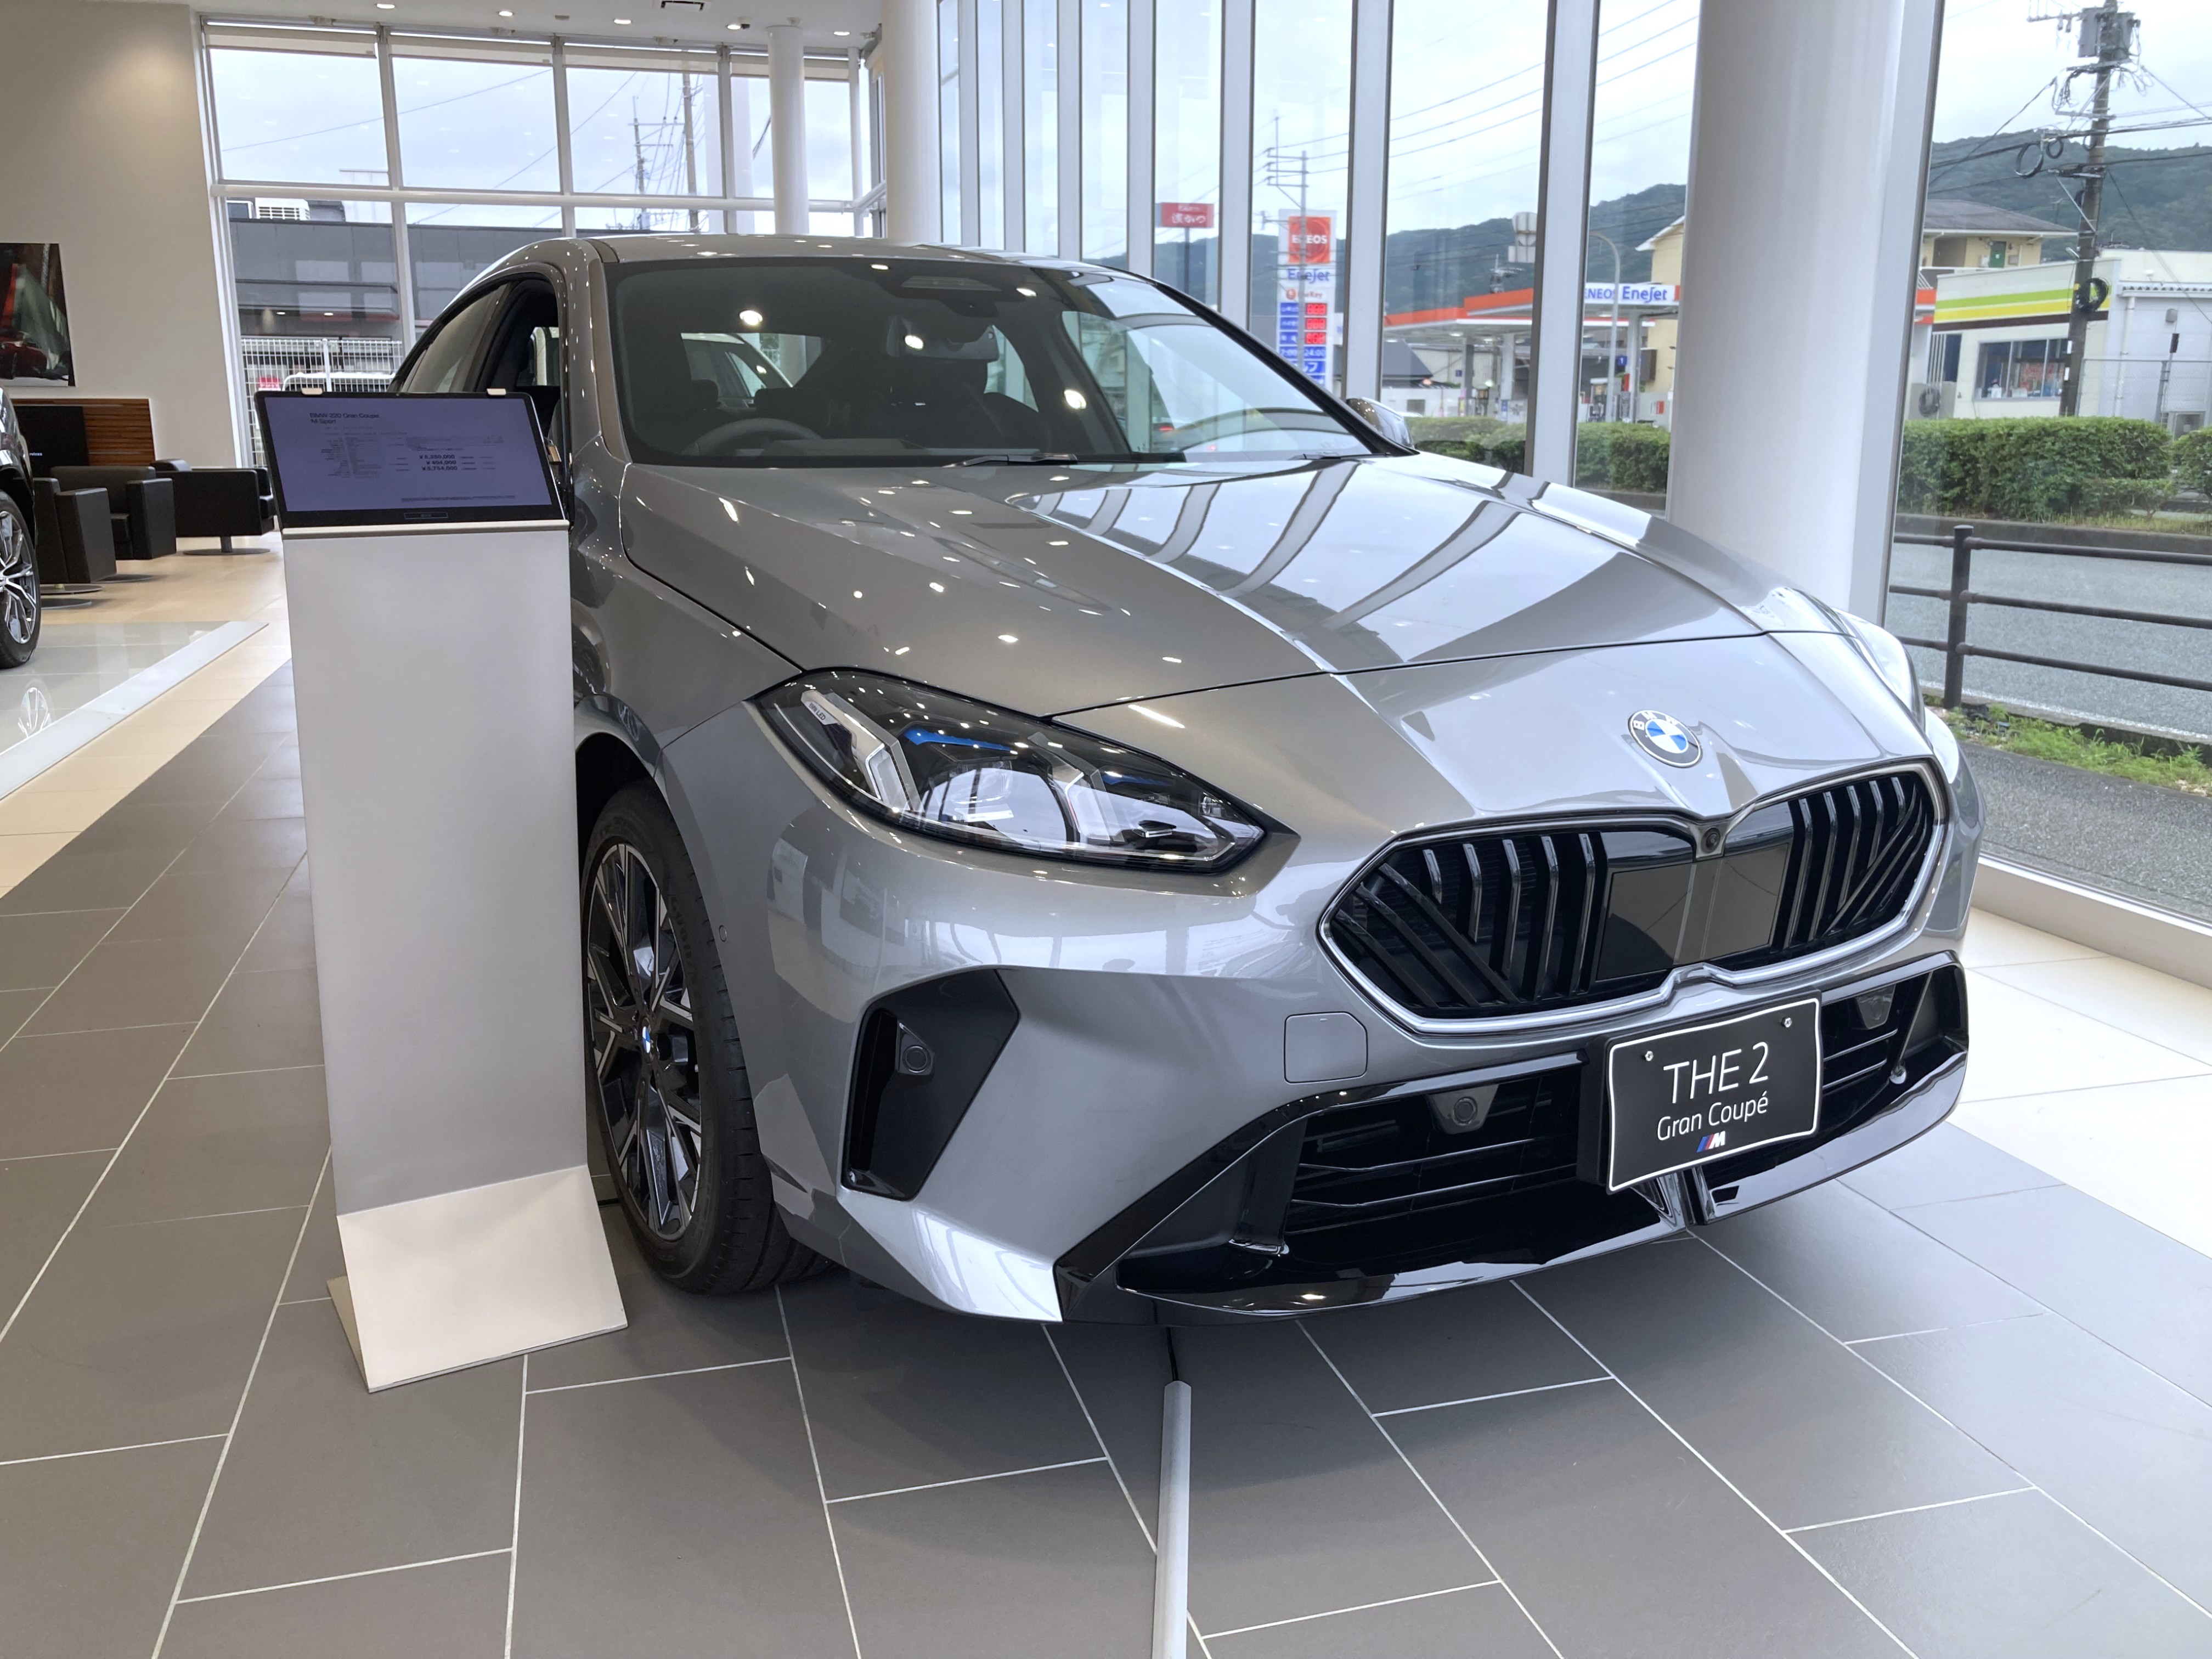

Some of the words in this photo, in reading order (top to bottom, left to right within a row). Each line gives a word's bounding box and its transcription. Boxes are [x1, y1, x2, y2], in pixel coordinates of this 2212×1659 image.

[1584, 288, 1615, 299] NEO
[816, 710, 826, 720] LED
[1633, 711, 1679, 731] BMW
[1663, 1048, 1742, 1104] THE
[1749, 1041, 1768, 1084] 2
[1657, 1113, 1701, 1141] Gran
[1708, 1090, 1768, 1126] Coupé
